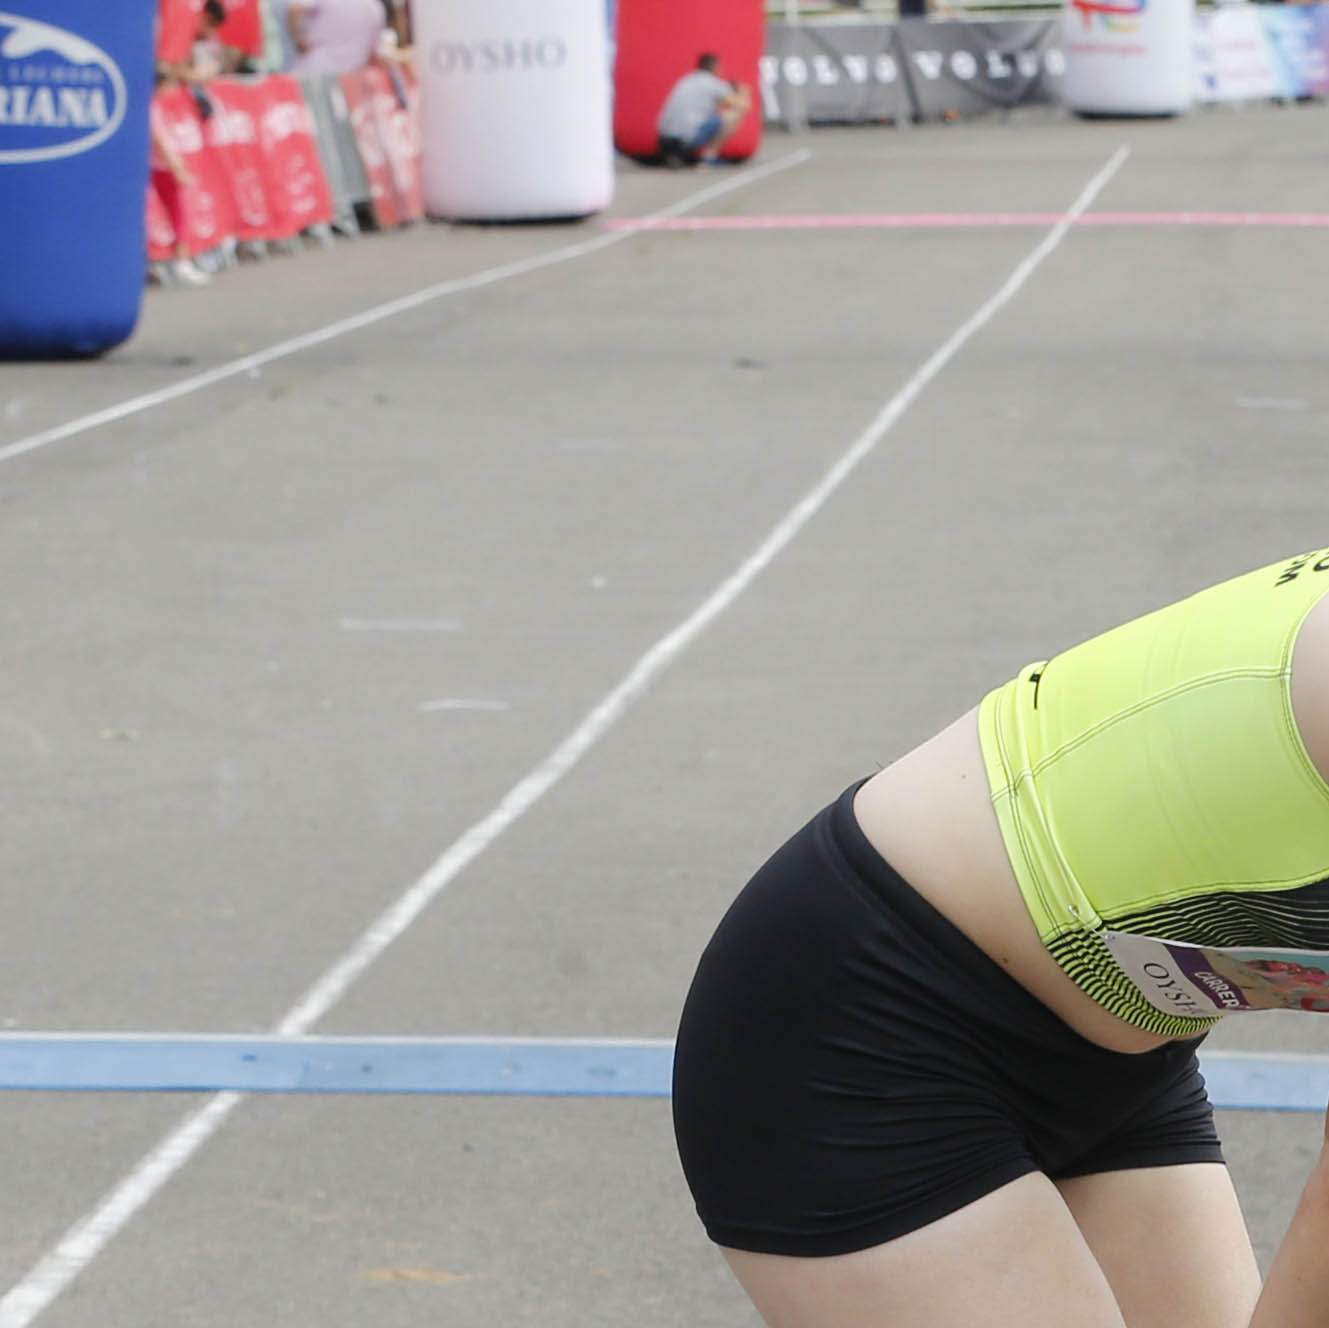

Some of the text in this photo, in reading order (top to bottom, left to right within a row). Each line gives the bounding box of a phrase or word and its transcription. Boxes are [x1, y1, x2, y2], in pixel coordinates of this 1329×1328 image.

[431, 37, 567, 74] OYSHO
[912, 48, 1067, 81] VOLVO
[1194, 971, 1246, 1009] CARRER
